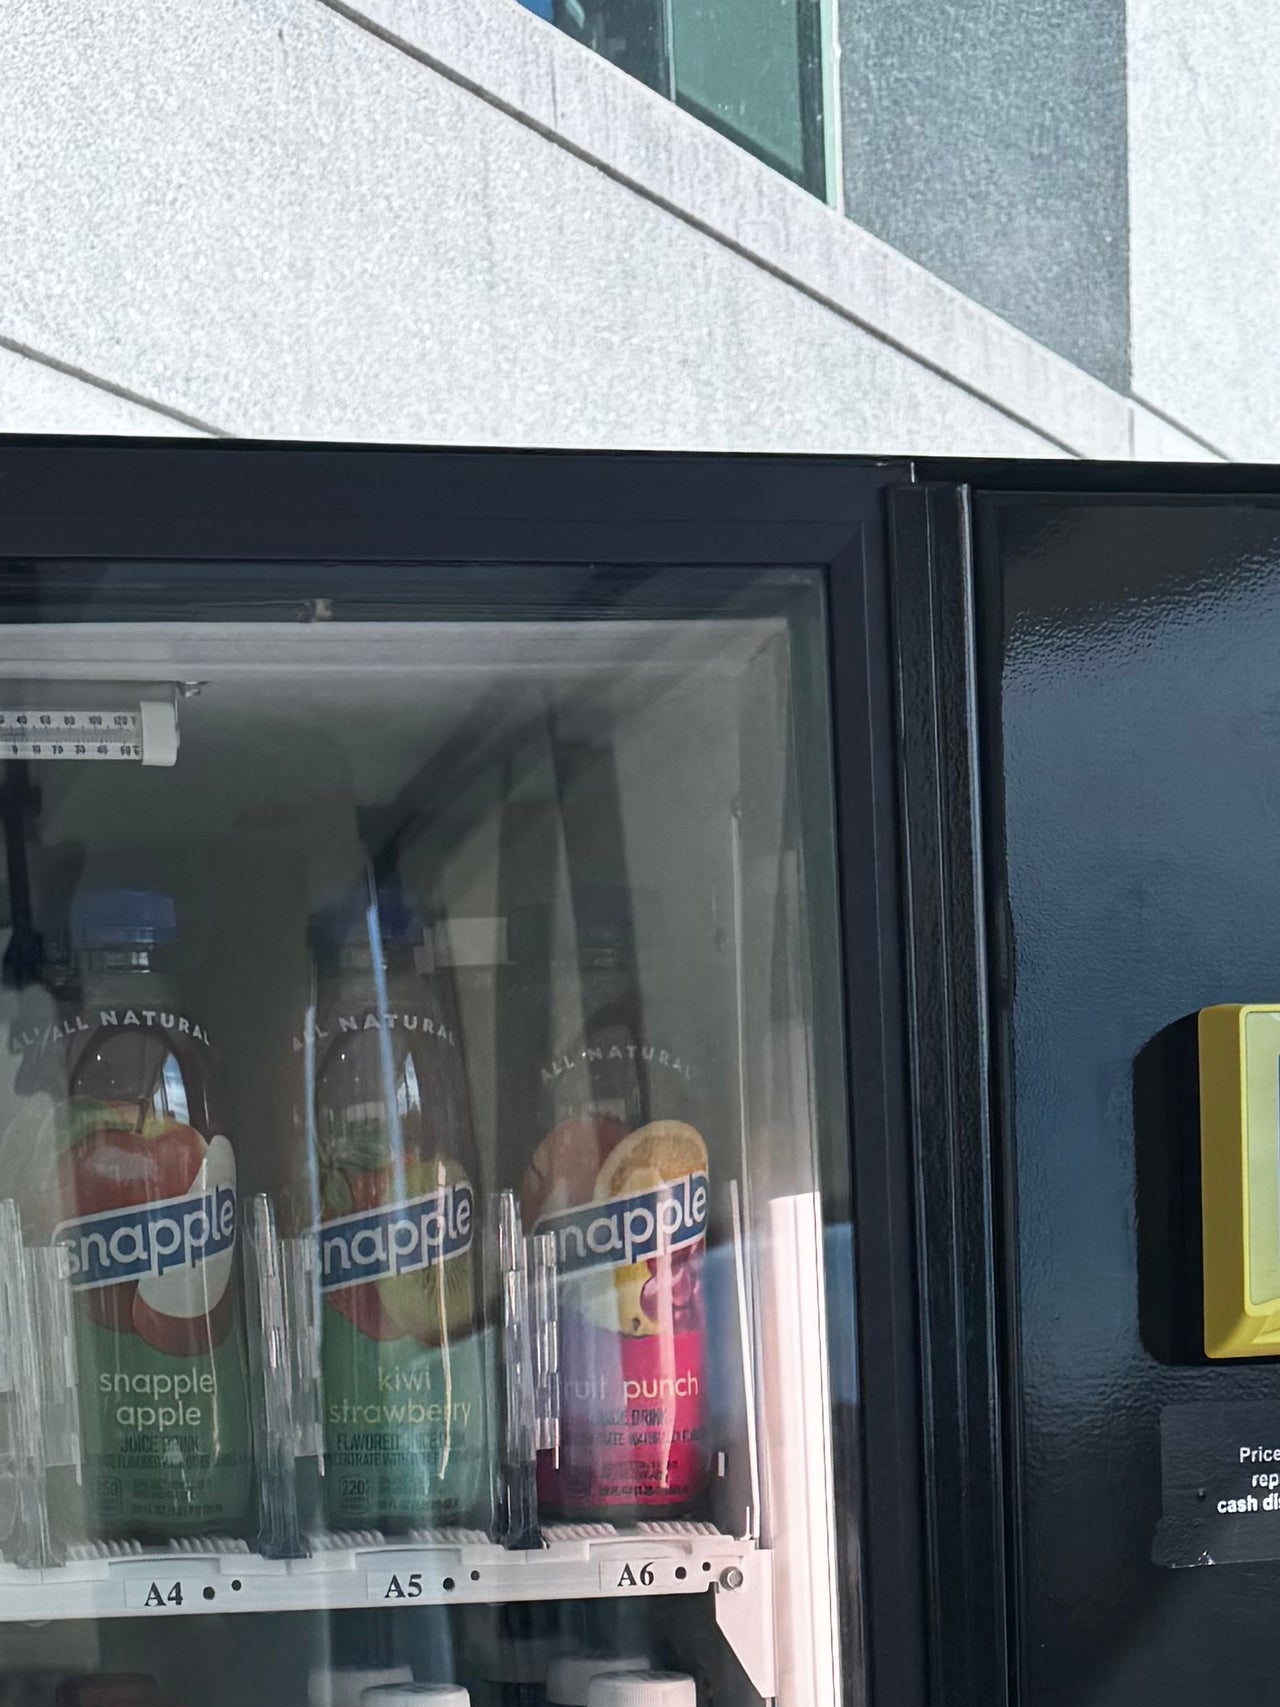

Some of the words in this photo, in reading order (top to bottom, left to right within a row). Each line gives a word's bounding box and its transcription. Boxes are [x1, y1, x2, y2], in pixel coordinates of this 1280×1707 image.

[52, 1016, 89, 1042] ALL
[100, 1010, 211, 1046] NATURAL
[339, 1013, 455, 1046] NATURAL
[320, 1185, 470, 1275] napple
[558, 1175, 706, 1263] napple
[100, 1368, 213, 1400] snapple
[379, 1366, 431, 1391] kiwi
[624, 1371, 698, 1408] punch
[117, 1401, 201, 1432] apple
[1217, 1495, 1258, 1514] cash
[383, 1573, 423, 1599] A5
[617, 1562, 654, 1587] A6
[143, 1581, 184, 1607] A4
